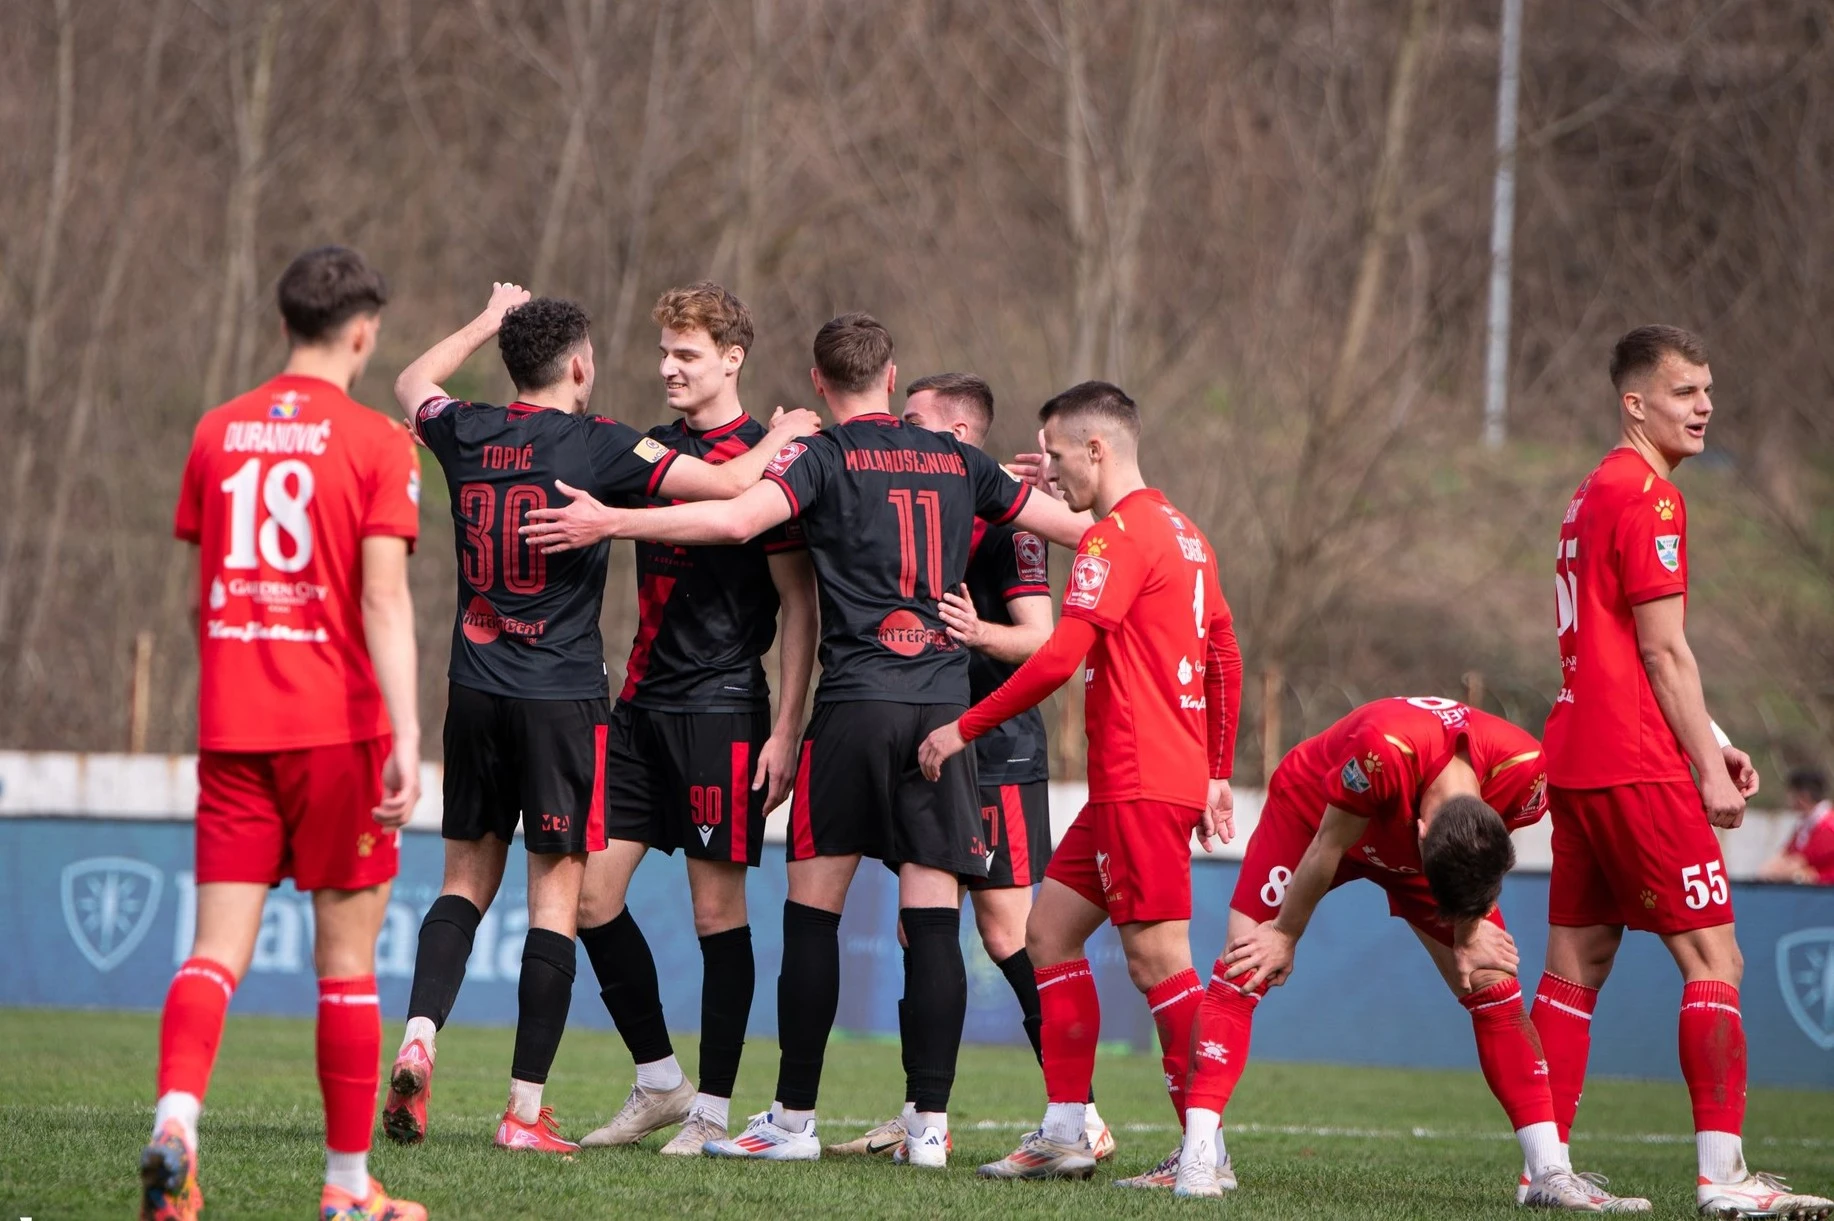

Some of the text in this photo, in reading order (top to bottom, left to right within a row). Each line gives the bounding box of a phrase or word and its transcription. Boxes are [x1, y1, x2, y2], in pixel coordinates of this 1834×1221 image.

[482, 444, 534, 471] TOPIĆ
[220, 457, 315, 573] 18
[460, 483, 548, 594] 30
[888, 488, 943, 601] 11
[690, 785, 722, 825] 90
[1681, 859, 1729, 910] 55
[1068, 969, 1092, 979] KEL
